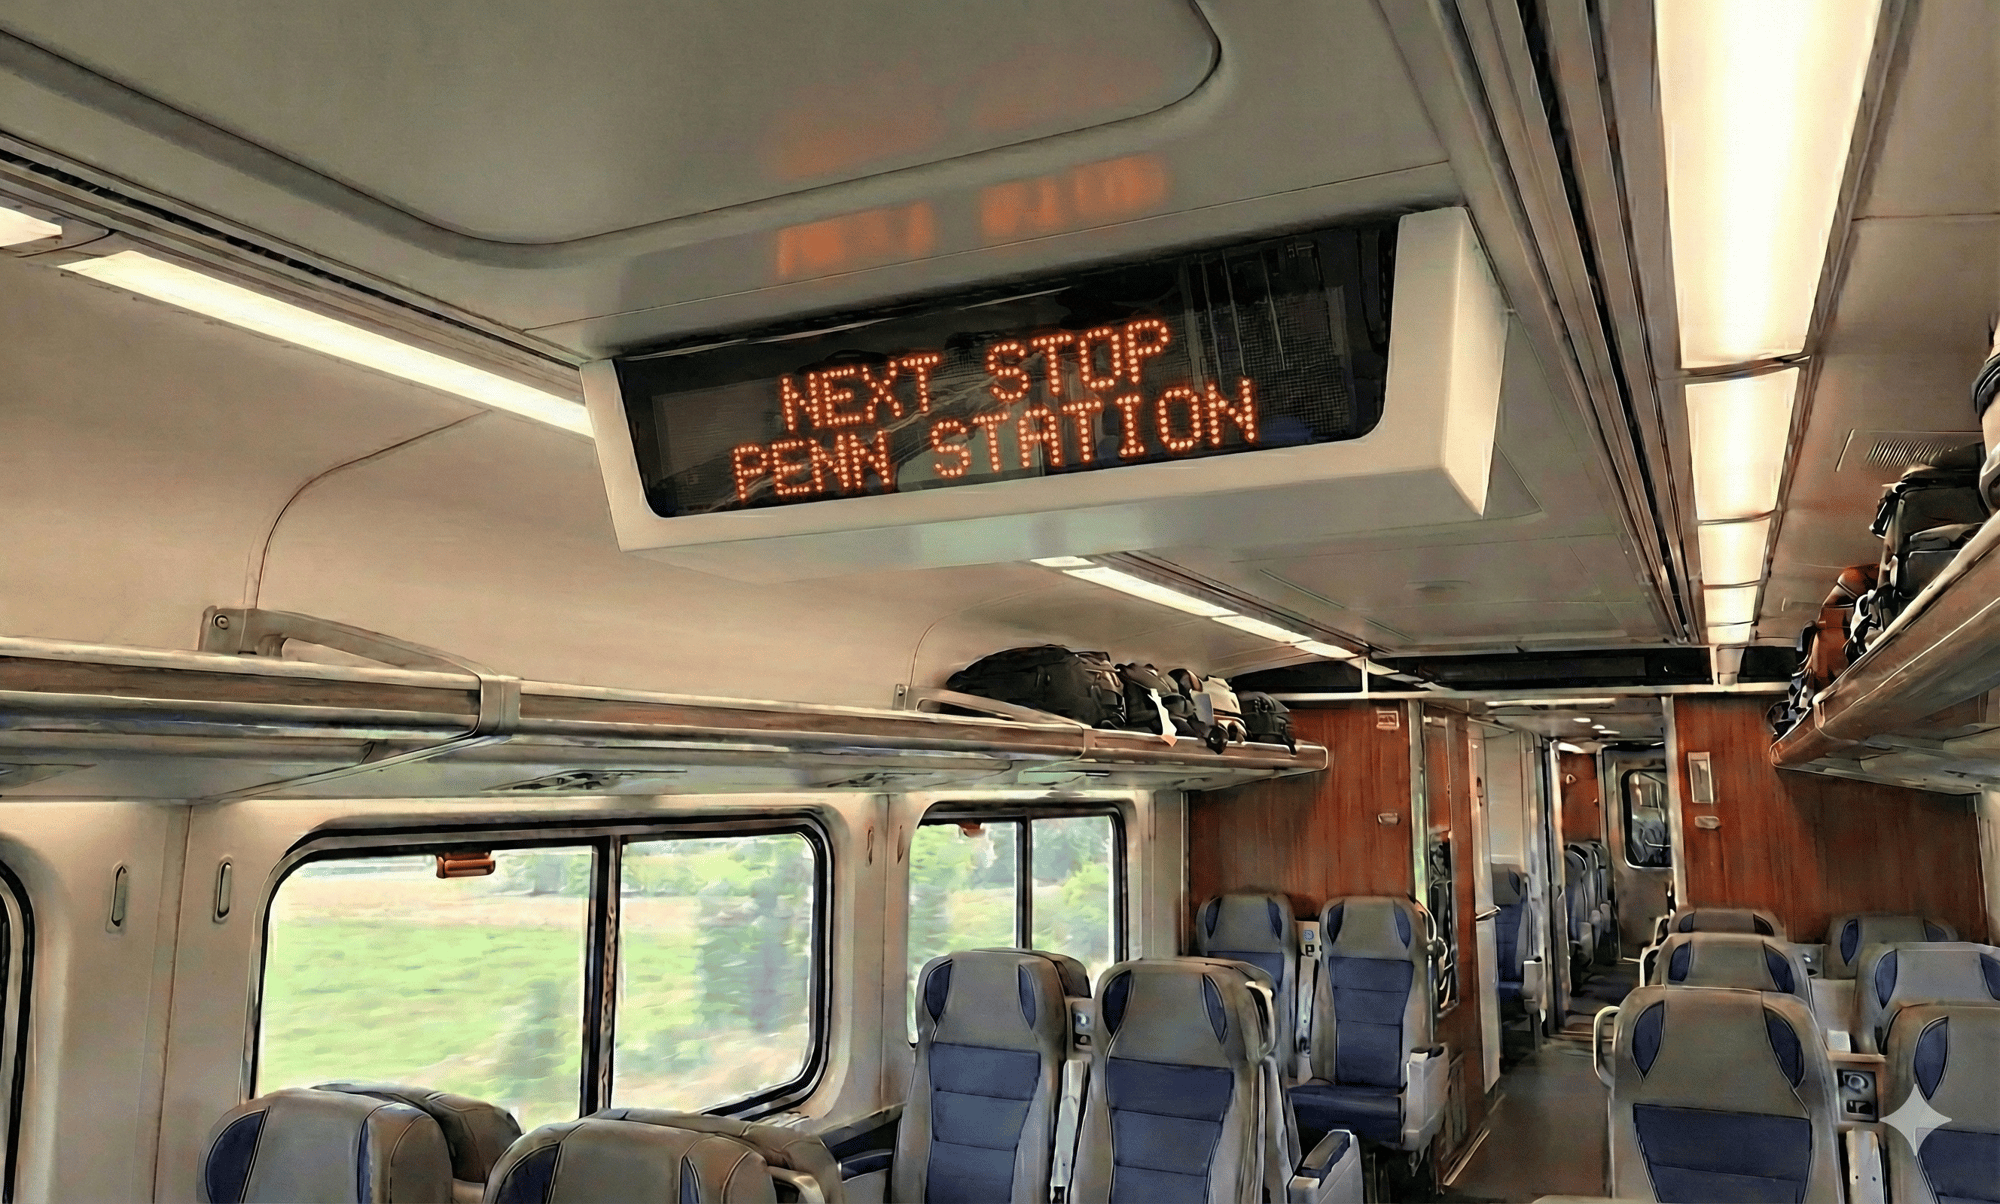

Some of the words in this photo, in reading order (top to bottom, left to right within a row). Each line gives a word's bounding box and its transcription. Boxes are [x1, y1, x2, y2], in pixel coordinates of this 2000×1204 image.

[780, 355, 939, 431] NEXT
[987, 319, 1169, 402] STOP
[733, 431, 892, 501] PENN
[931, 378, 1257, 478] STATION
